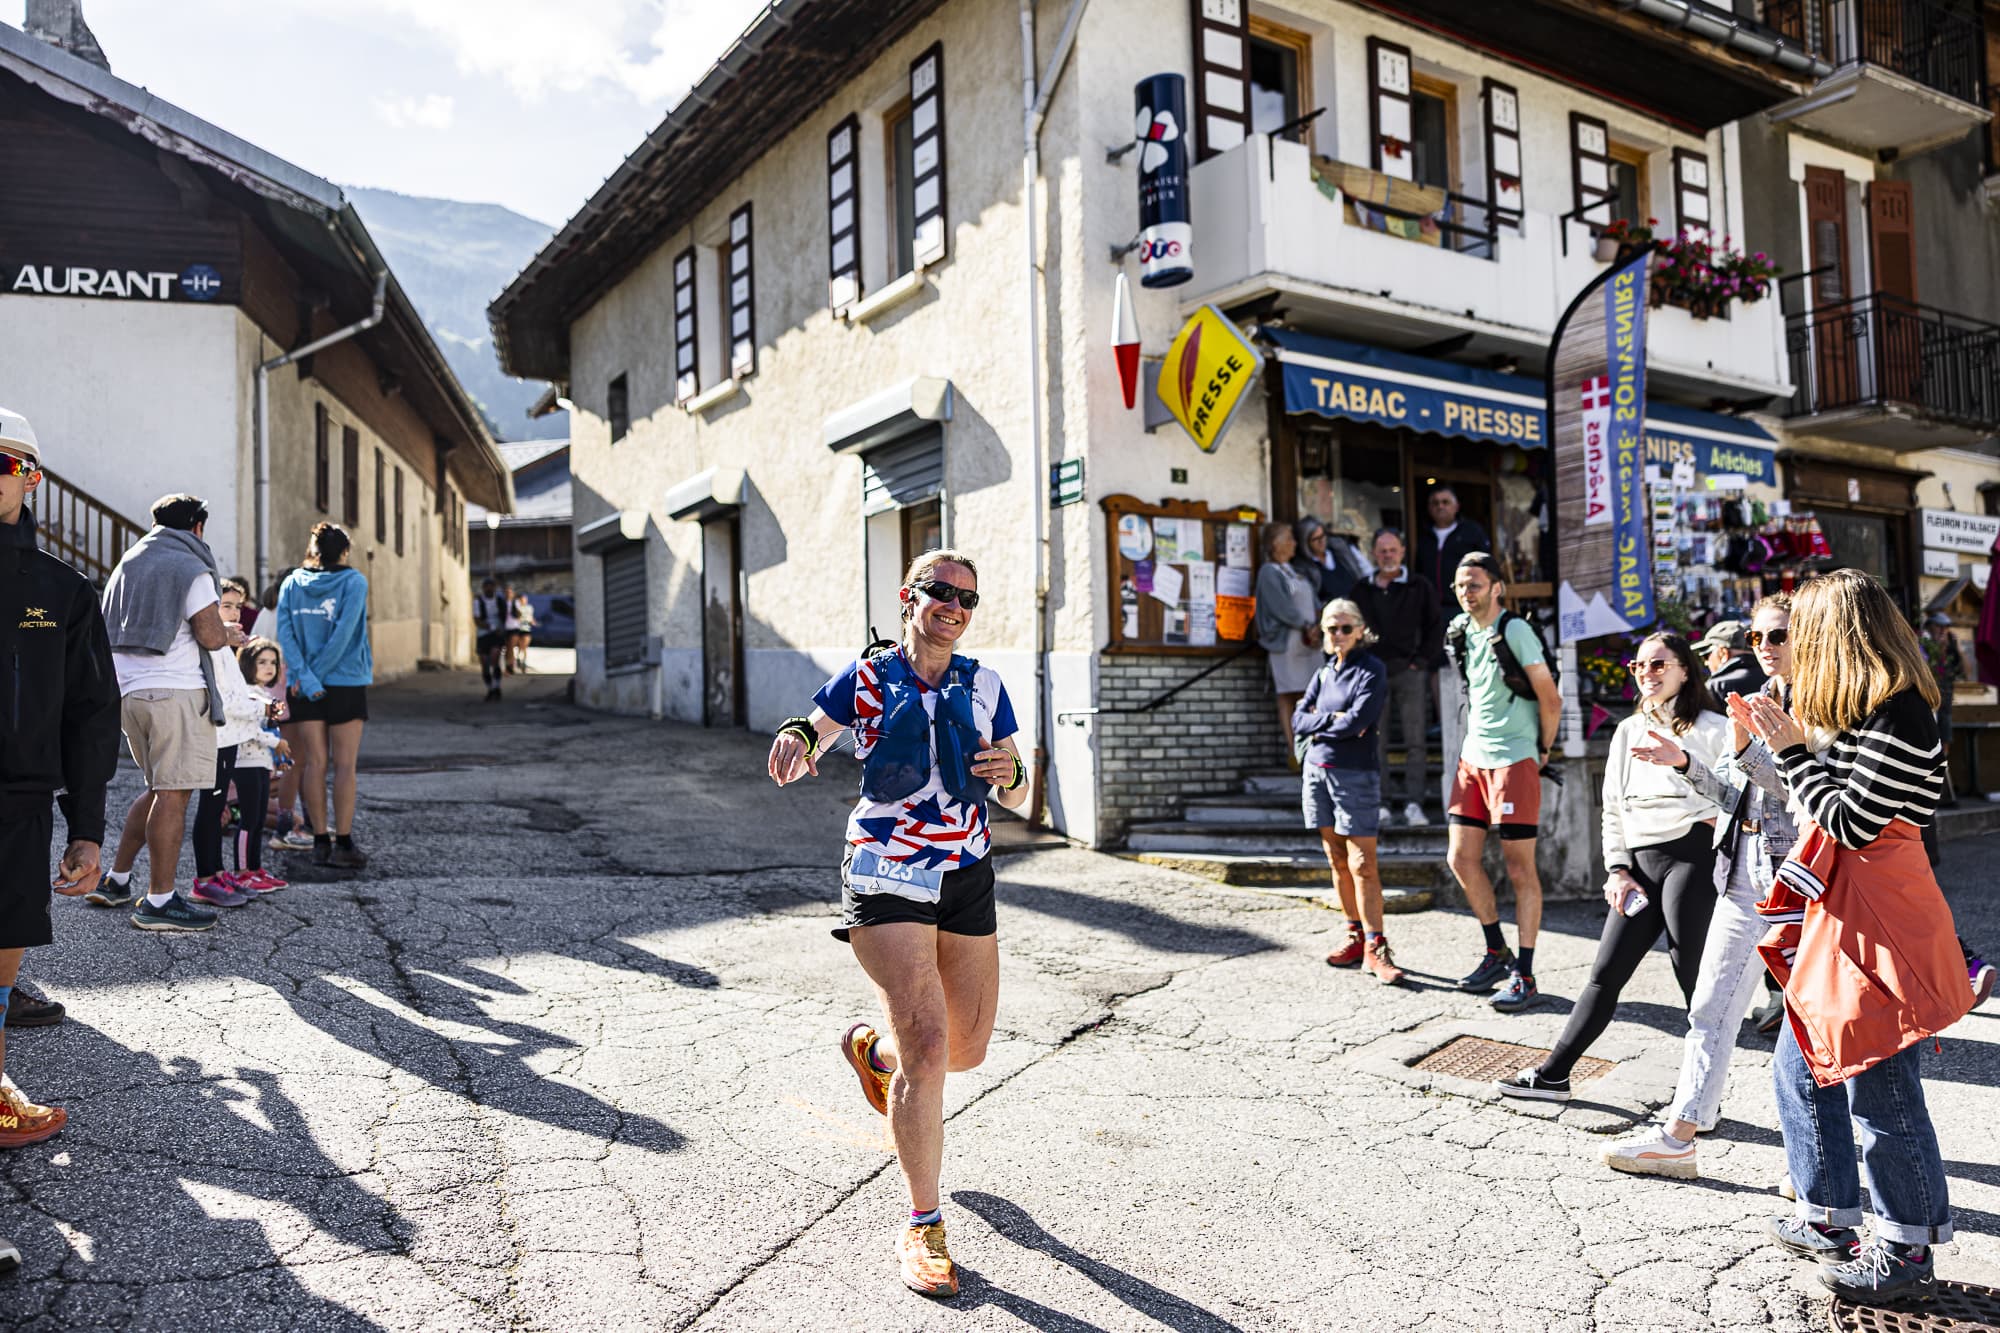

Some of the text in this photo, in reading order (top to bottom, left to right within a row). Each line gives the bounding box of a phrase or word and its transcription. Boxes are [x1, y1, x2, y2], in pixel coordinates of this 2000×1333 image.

[13, 264, 178, 299] AURANT
[1192, 355, 1244, 439] PRESSE
[1311, 378, 1407, 419] TABAC
[1443, 401, 1542, 441] PRESSE
[1926, 513, 1961, 529] FLEURON
[877, 857, 914, 881] 623
